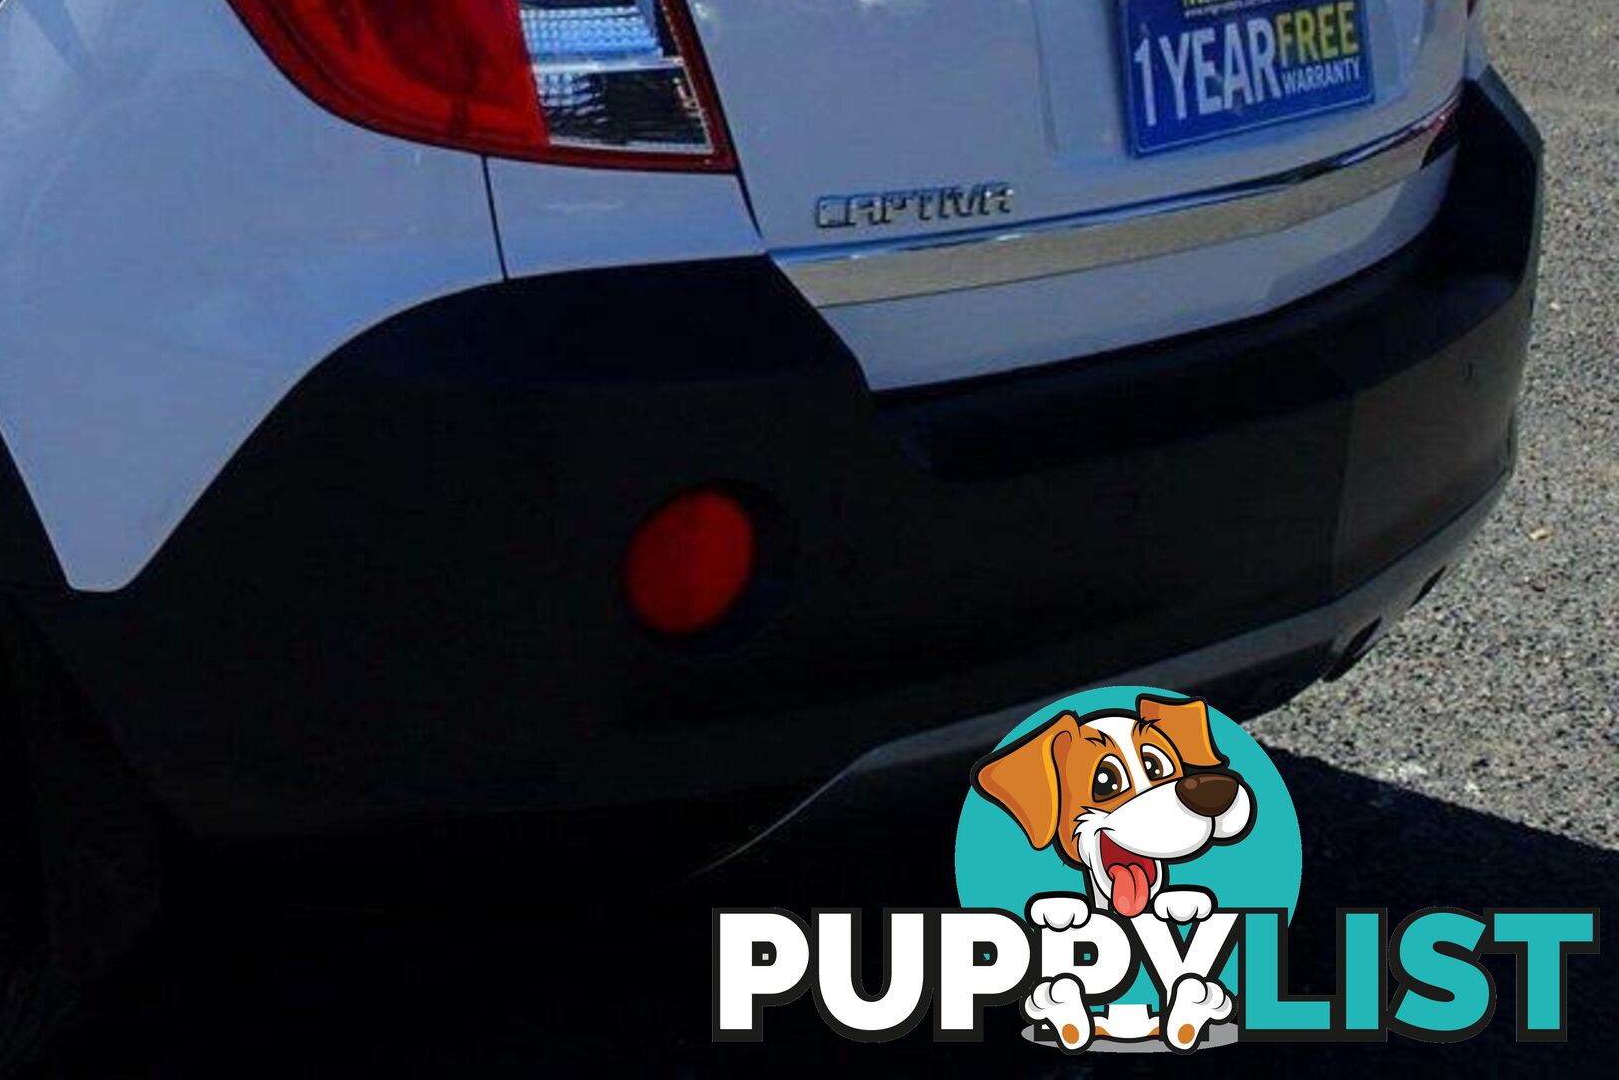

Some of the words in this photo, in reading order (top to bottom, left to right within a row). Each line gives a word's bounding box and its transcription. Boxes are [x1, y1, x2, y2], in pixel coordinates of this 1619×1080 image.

[1134, 38, 1157, 127] 1
[1158, 17, 1281, 119] YEAR
[1276, 1, 1359, 67] FREE
[1283, 57, 1360, 95] WARRANTY
[816, 182, 1013, 228] CAPTIVA
